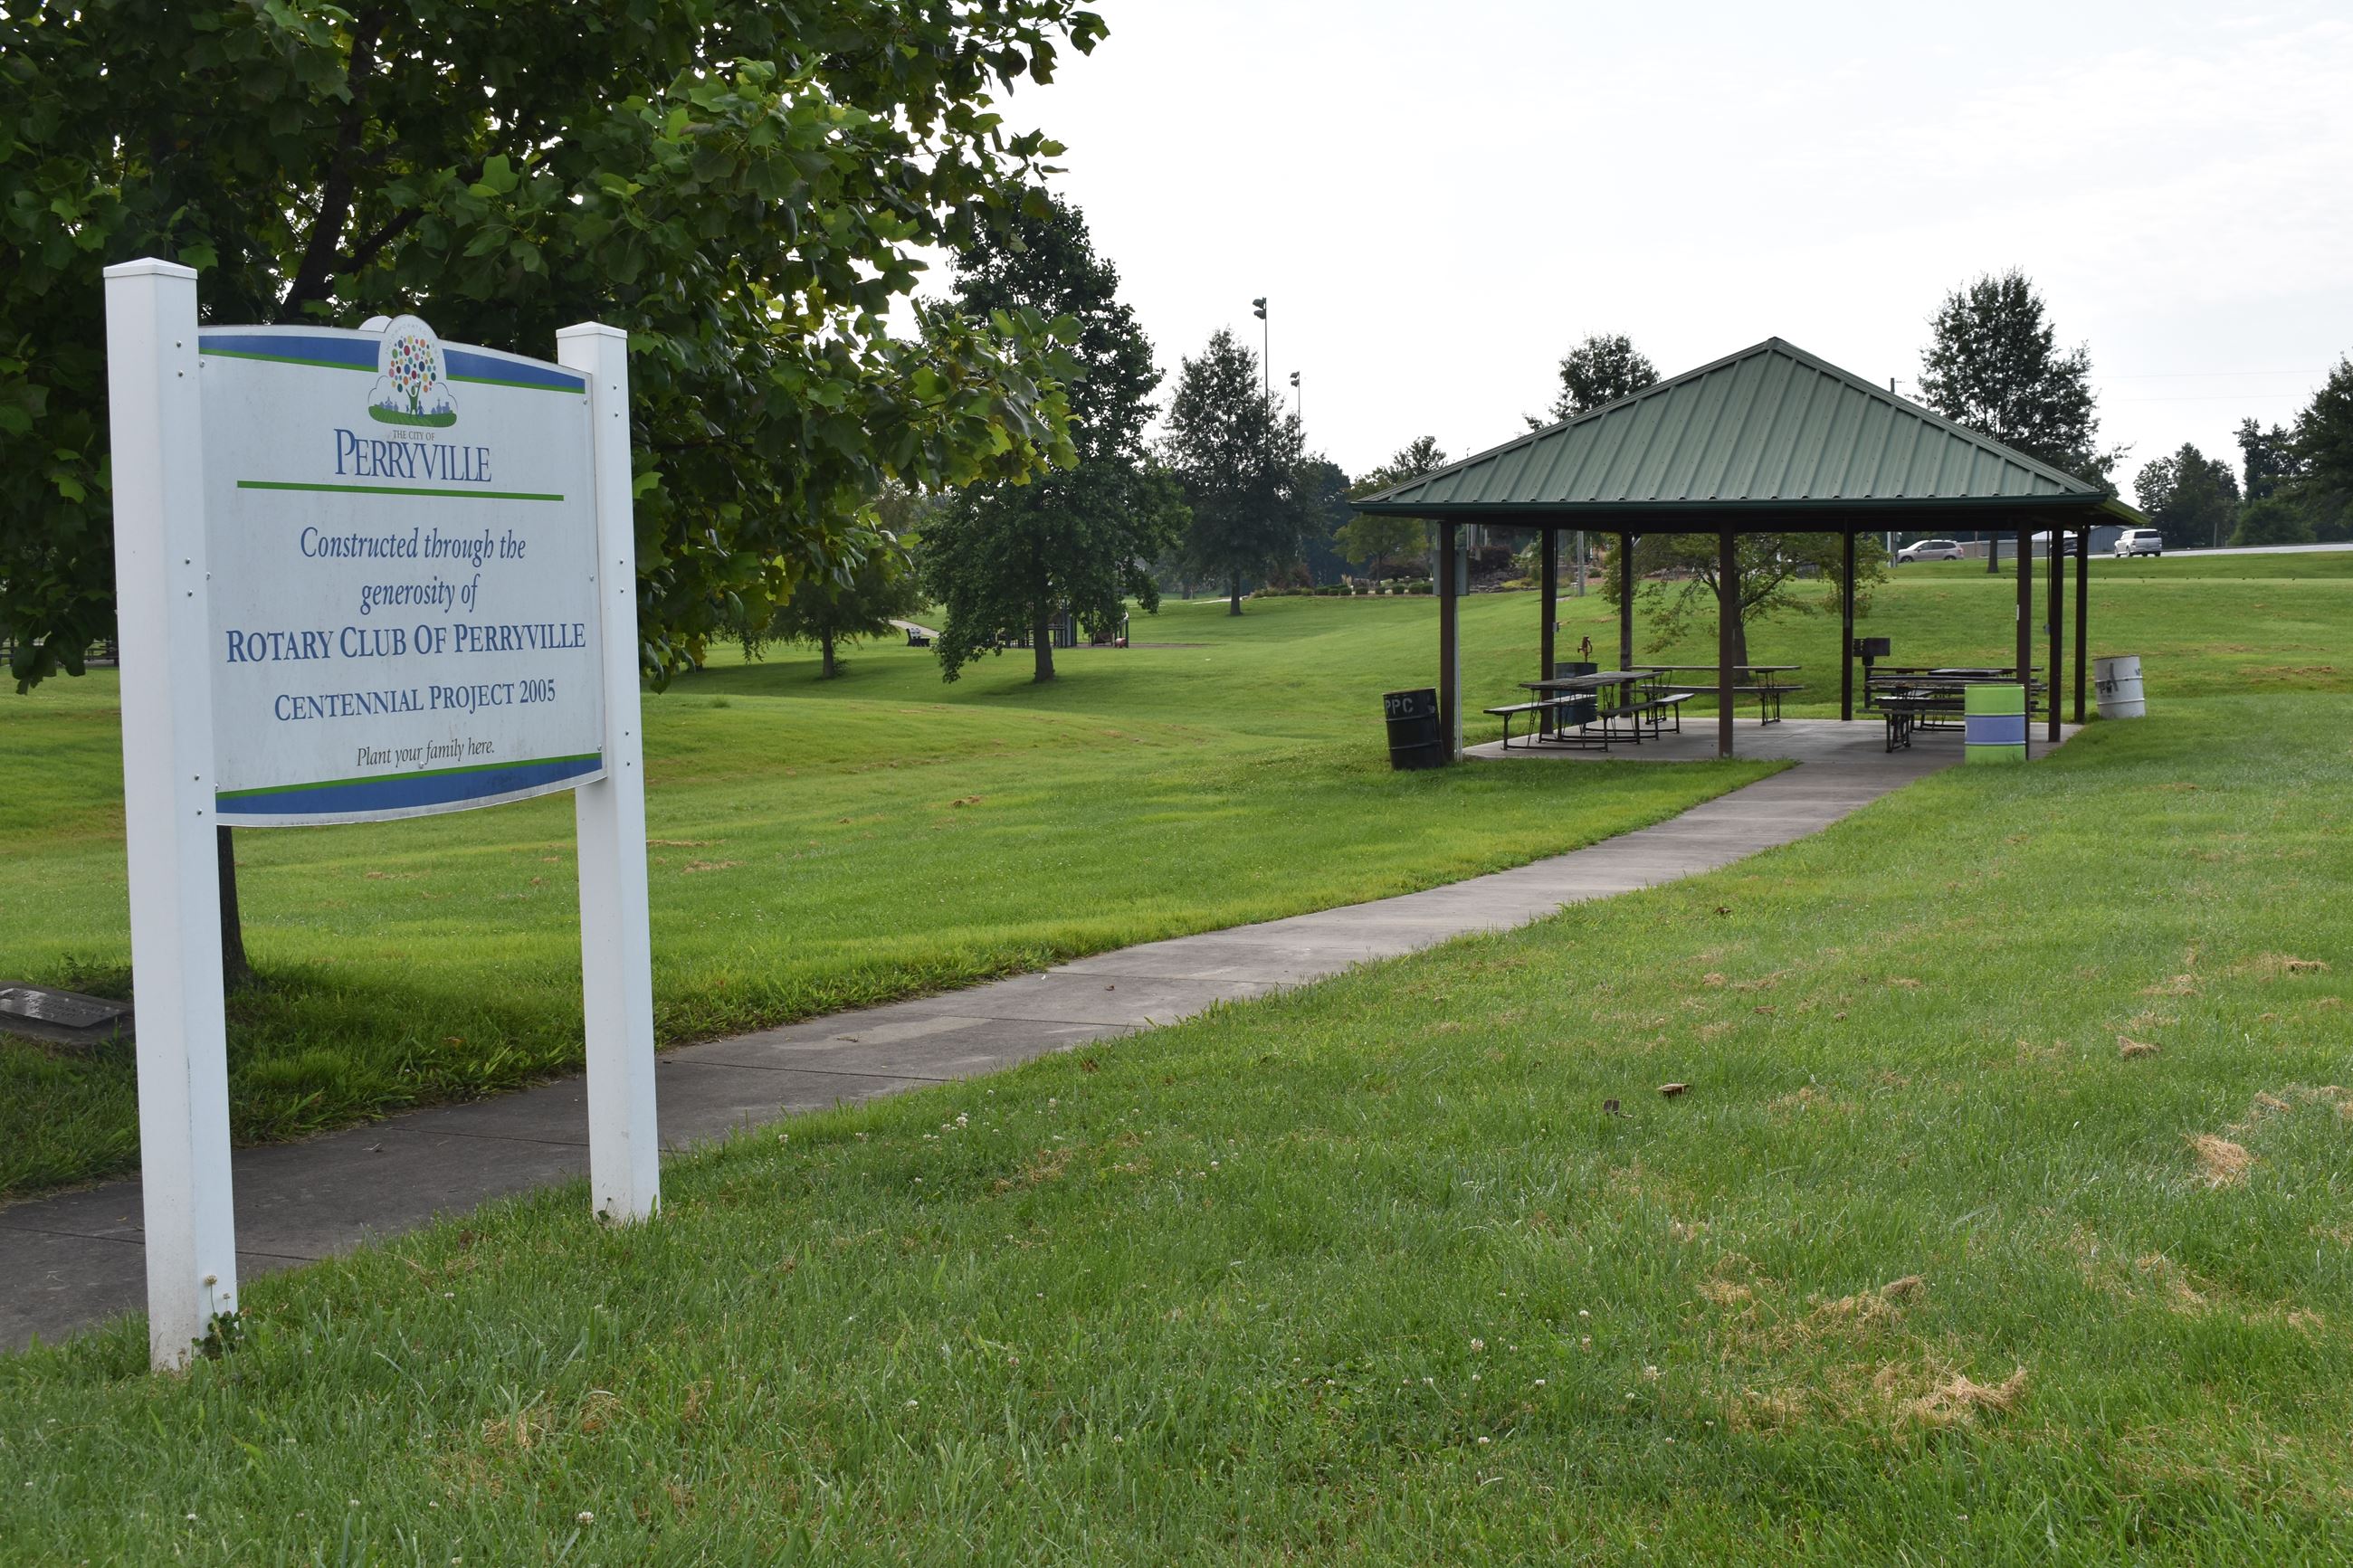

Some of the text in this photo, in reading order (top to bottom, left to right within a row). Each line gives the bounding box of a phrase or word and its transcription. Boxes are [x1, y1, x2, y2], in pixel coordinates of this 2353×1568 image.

[334, 428, 492, 482] PERRYVILLE
[393, 430, 435, 442] THE CITY OF
[300, 526, 526, 568] Constructed through the
[360, 573, 481, 615] generosity of
[226, 622, 586, 662] ROTARY CLUB OF PERRYVILLE
[274, 679, 556, 721] CENTENNIAL PROJECT 2005
[357, 737, 495, 767] Plant your family here.
